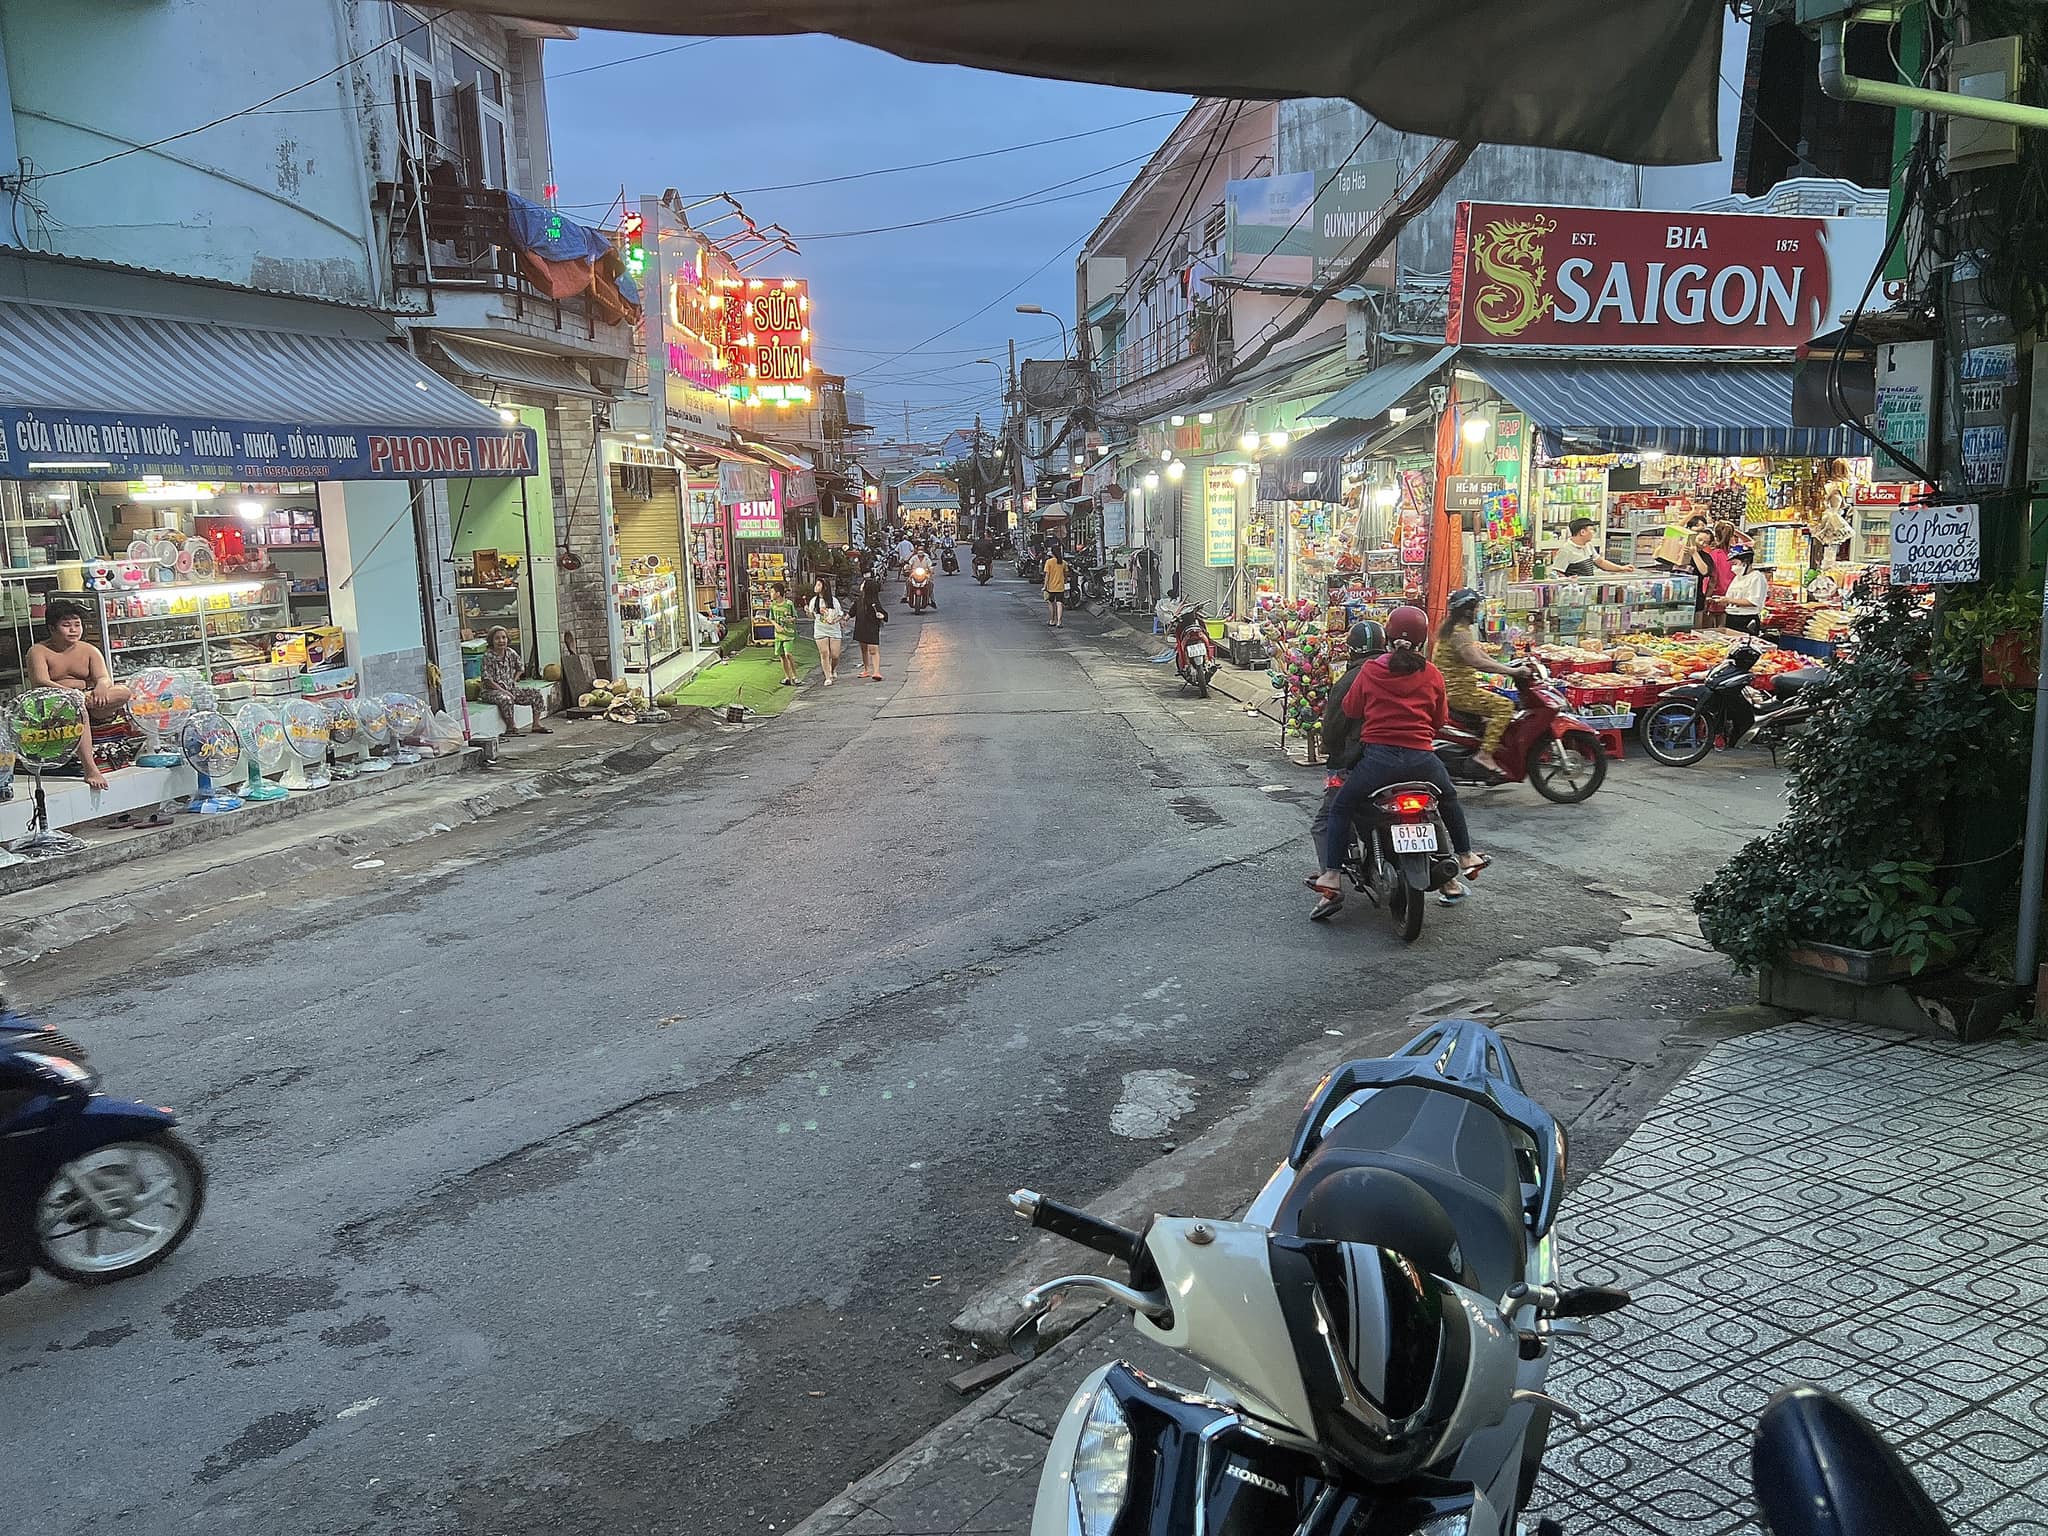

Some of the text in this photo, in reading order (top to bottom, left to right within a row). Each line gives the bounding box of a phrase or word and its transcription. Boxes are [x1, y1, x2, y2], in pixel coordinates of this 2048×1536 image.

[1571, 232, 1799, 252] EST. 1875
[1665, 226, 1708, 249] BIA
[1554, 257, 1805, 327] SAIGON
[754, 289, 801, 331] SỮA
[758, 335, 802, 379] BỈM
[16, 411, 49, 452] CỬA
[53, 418, 99, 454] HÀNG
[101, 421, 139, 461] ĐIỆN
[140, 423, 181, 456] NƯỚC
[192, 426, 234, 457] NHÔM
[243, 431, 279, 463] NHỰA
[288, 426, 305, 459] ĐỒ
[307, 434, 328, 459] GIA
[329, 436, 359, 464] DỤNG
[1498, 419, 1520, 438] TẠP
[368, 431, 531, 473] PHONG NHÃ
[1456, 478, 1479, 493] HẺM
[1397, 838, 1434, 851] 176.10
[1226, 1464, 1289, 1497] HONDA
